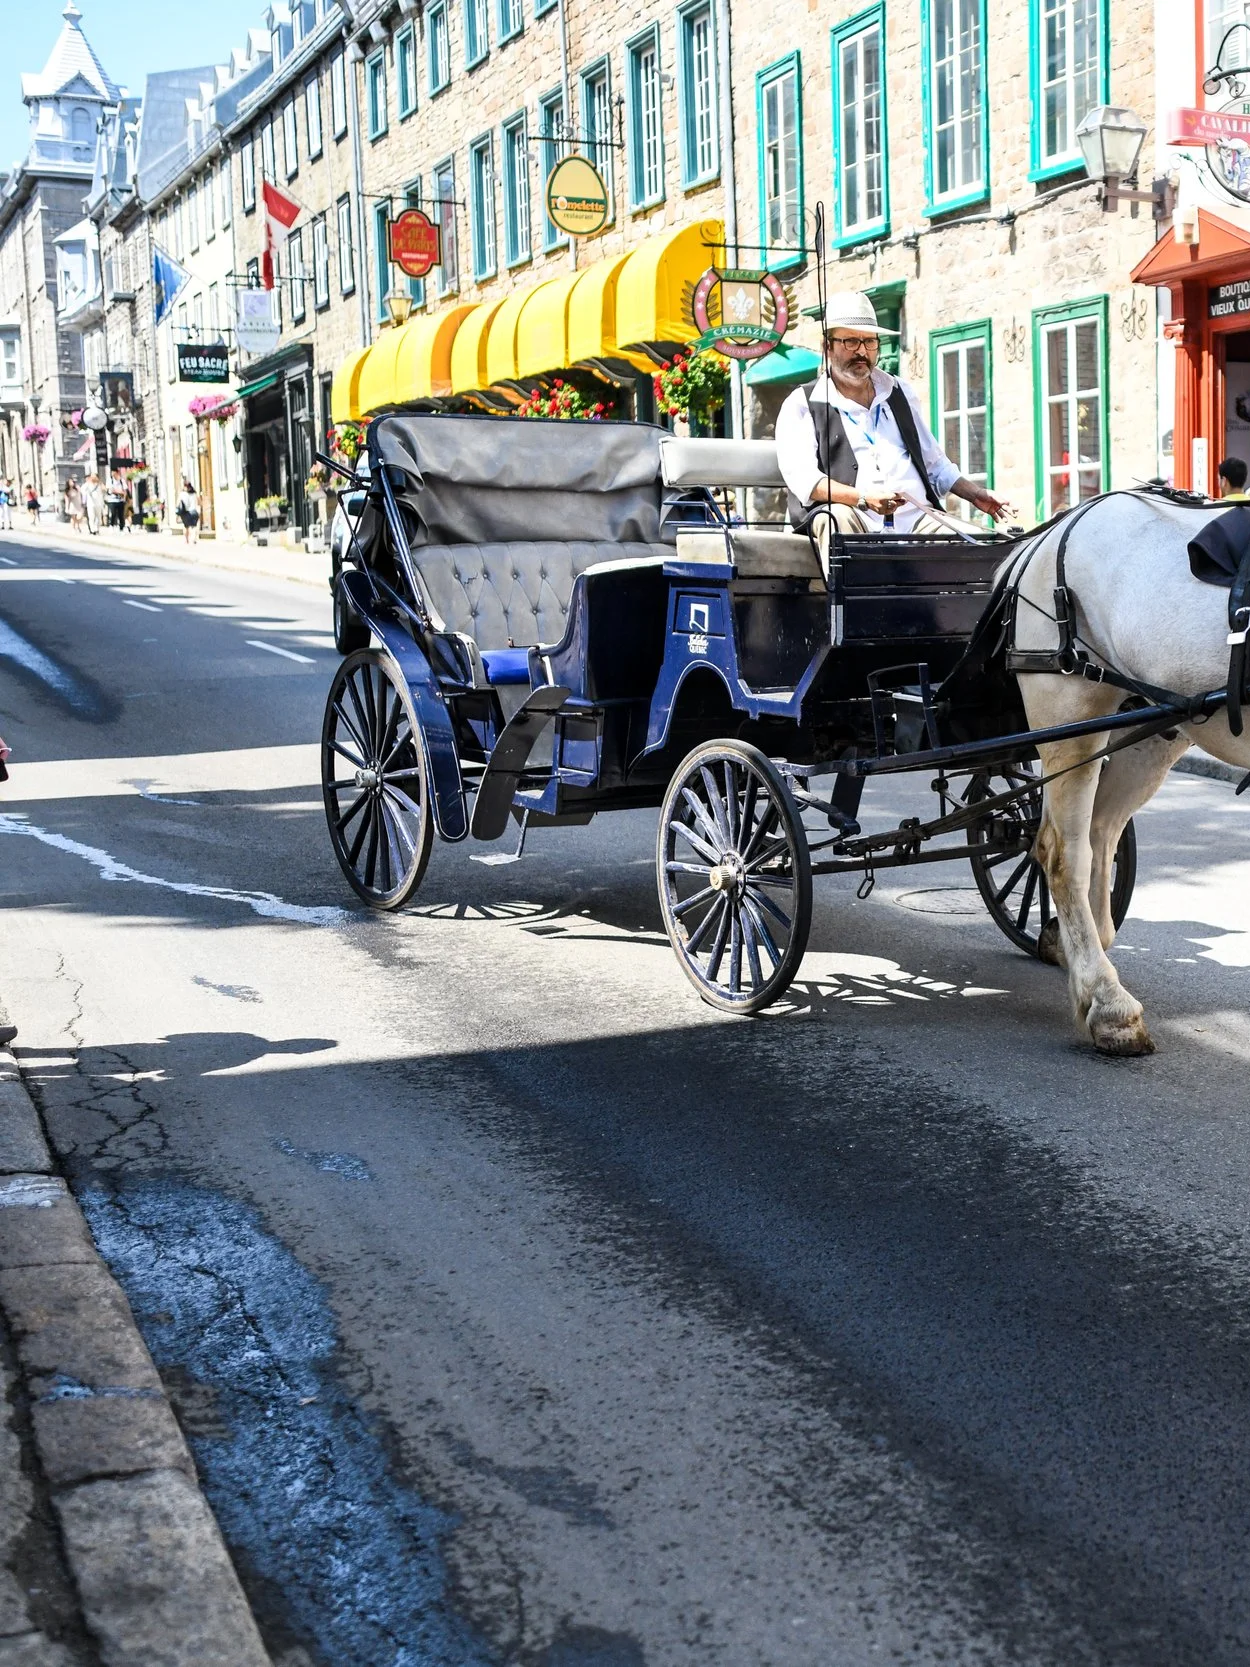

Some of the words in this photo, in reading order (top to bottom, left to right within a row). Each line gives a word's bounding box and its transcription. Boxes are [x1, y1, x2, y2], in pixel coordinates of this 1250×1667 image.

[1211, 301, 1236, 316] VIEUX
[713, 325, 772, 338] CRÉMAZIE
[180, 357, 198, 370] FEU
